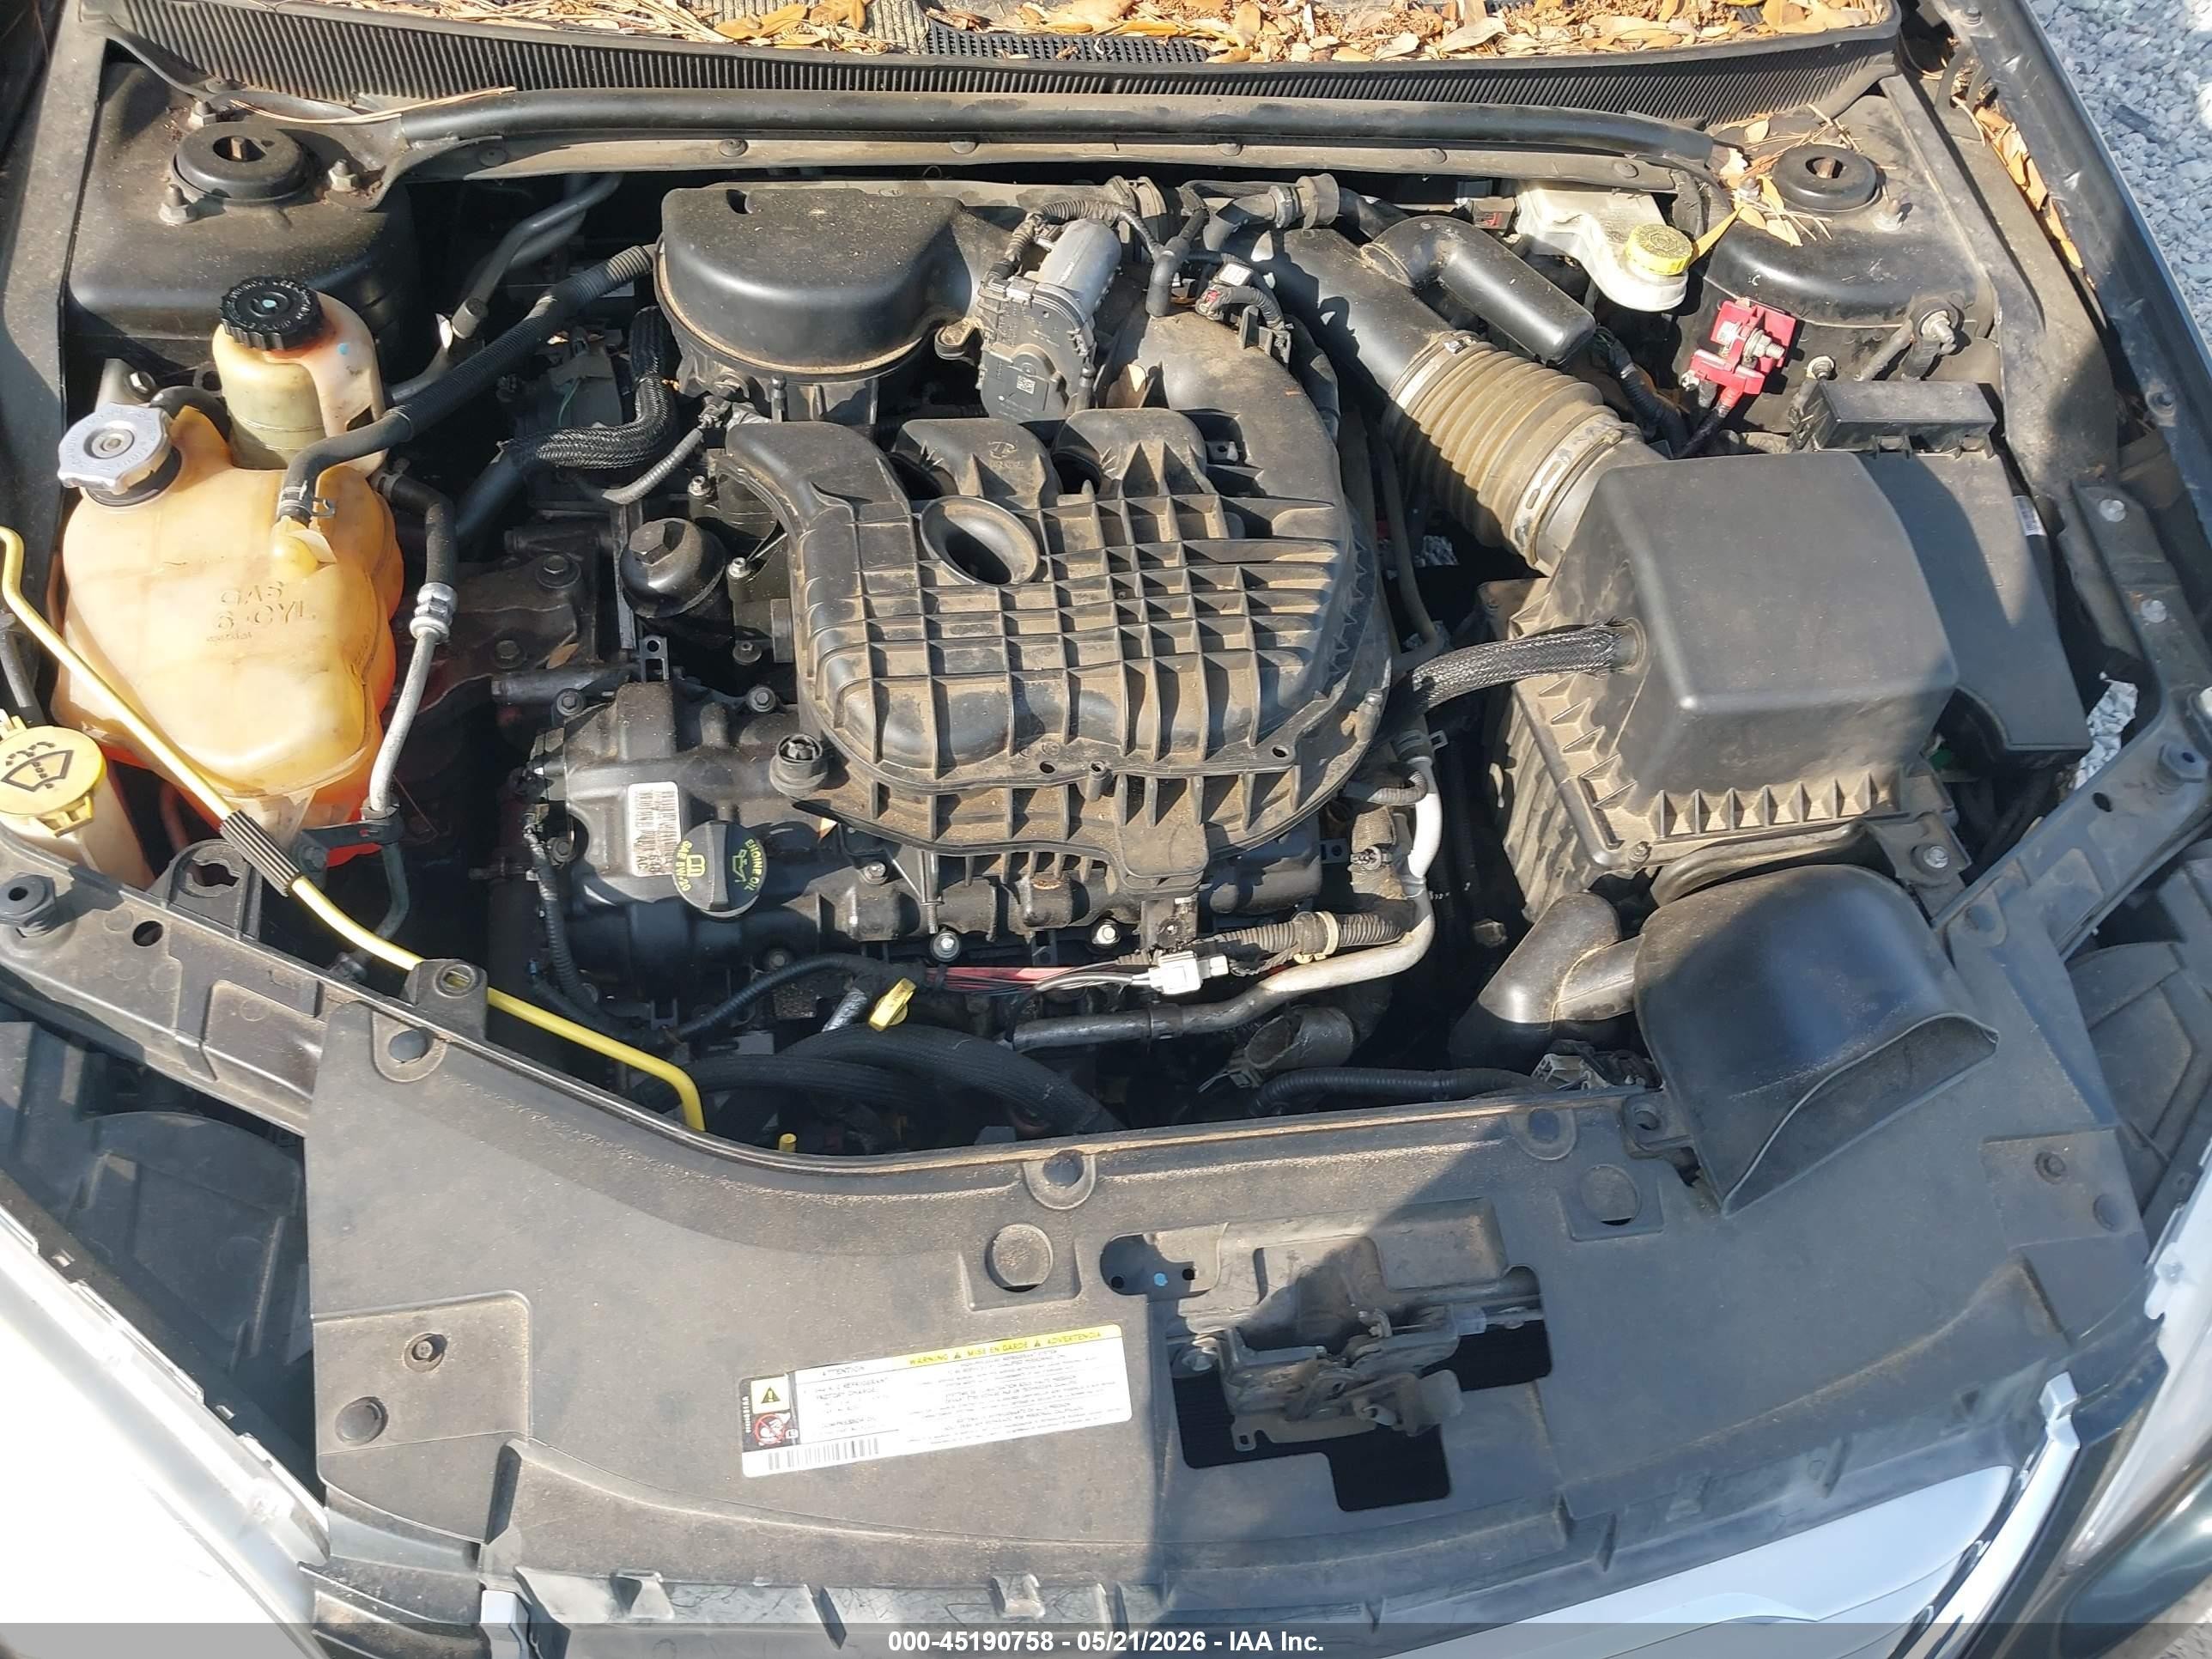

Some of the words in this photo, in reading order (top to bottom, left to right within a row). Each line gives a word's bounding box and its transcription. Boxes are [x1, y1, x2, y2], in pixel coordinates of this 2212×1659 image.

[676, 840, 693, 858] SAE
[744, 838, 763, 876] ENGINE
[744, 877, 761, 891] OIL
